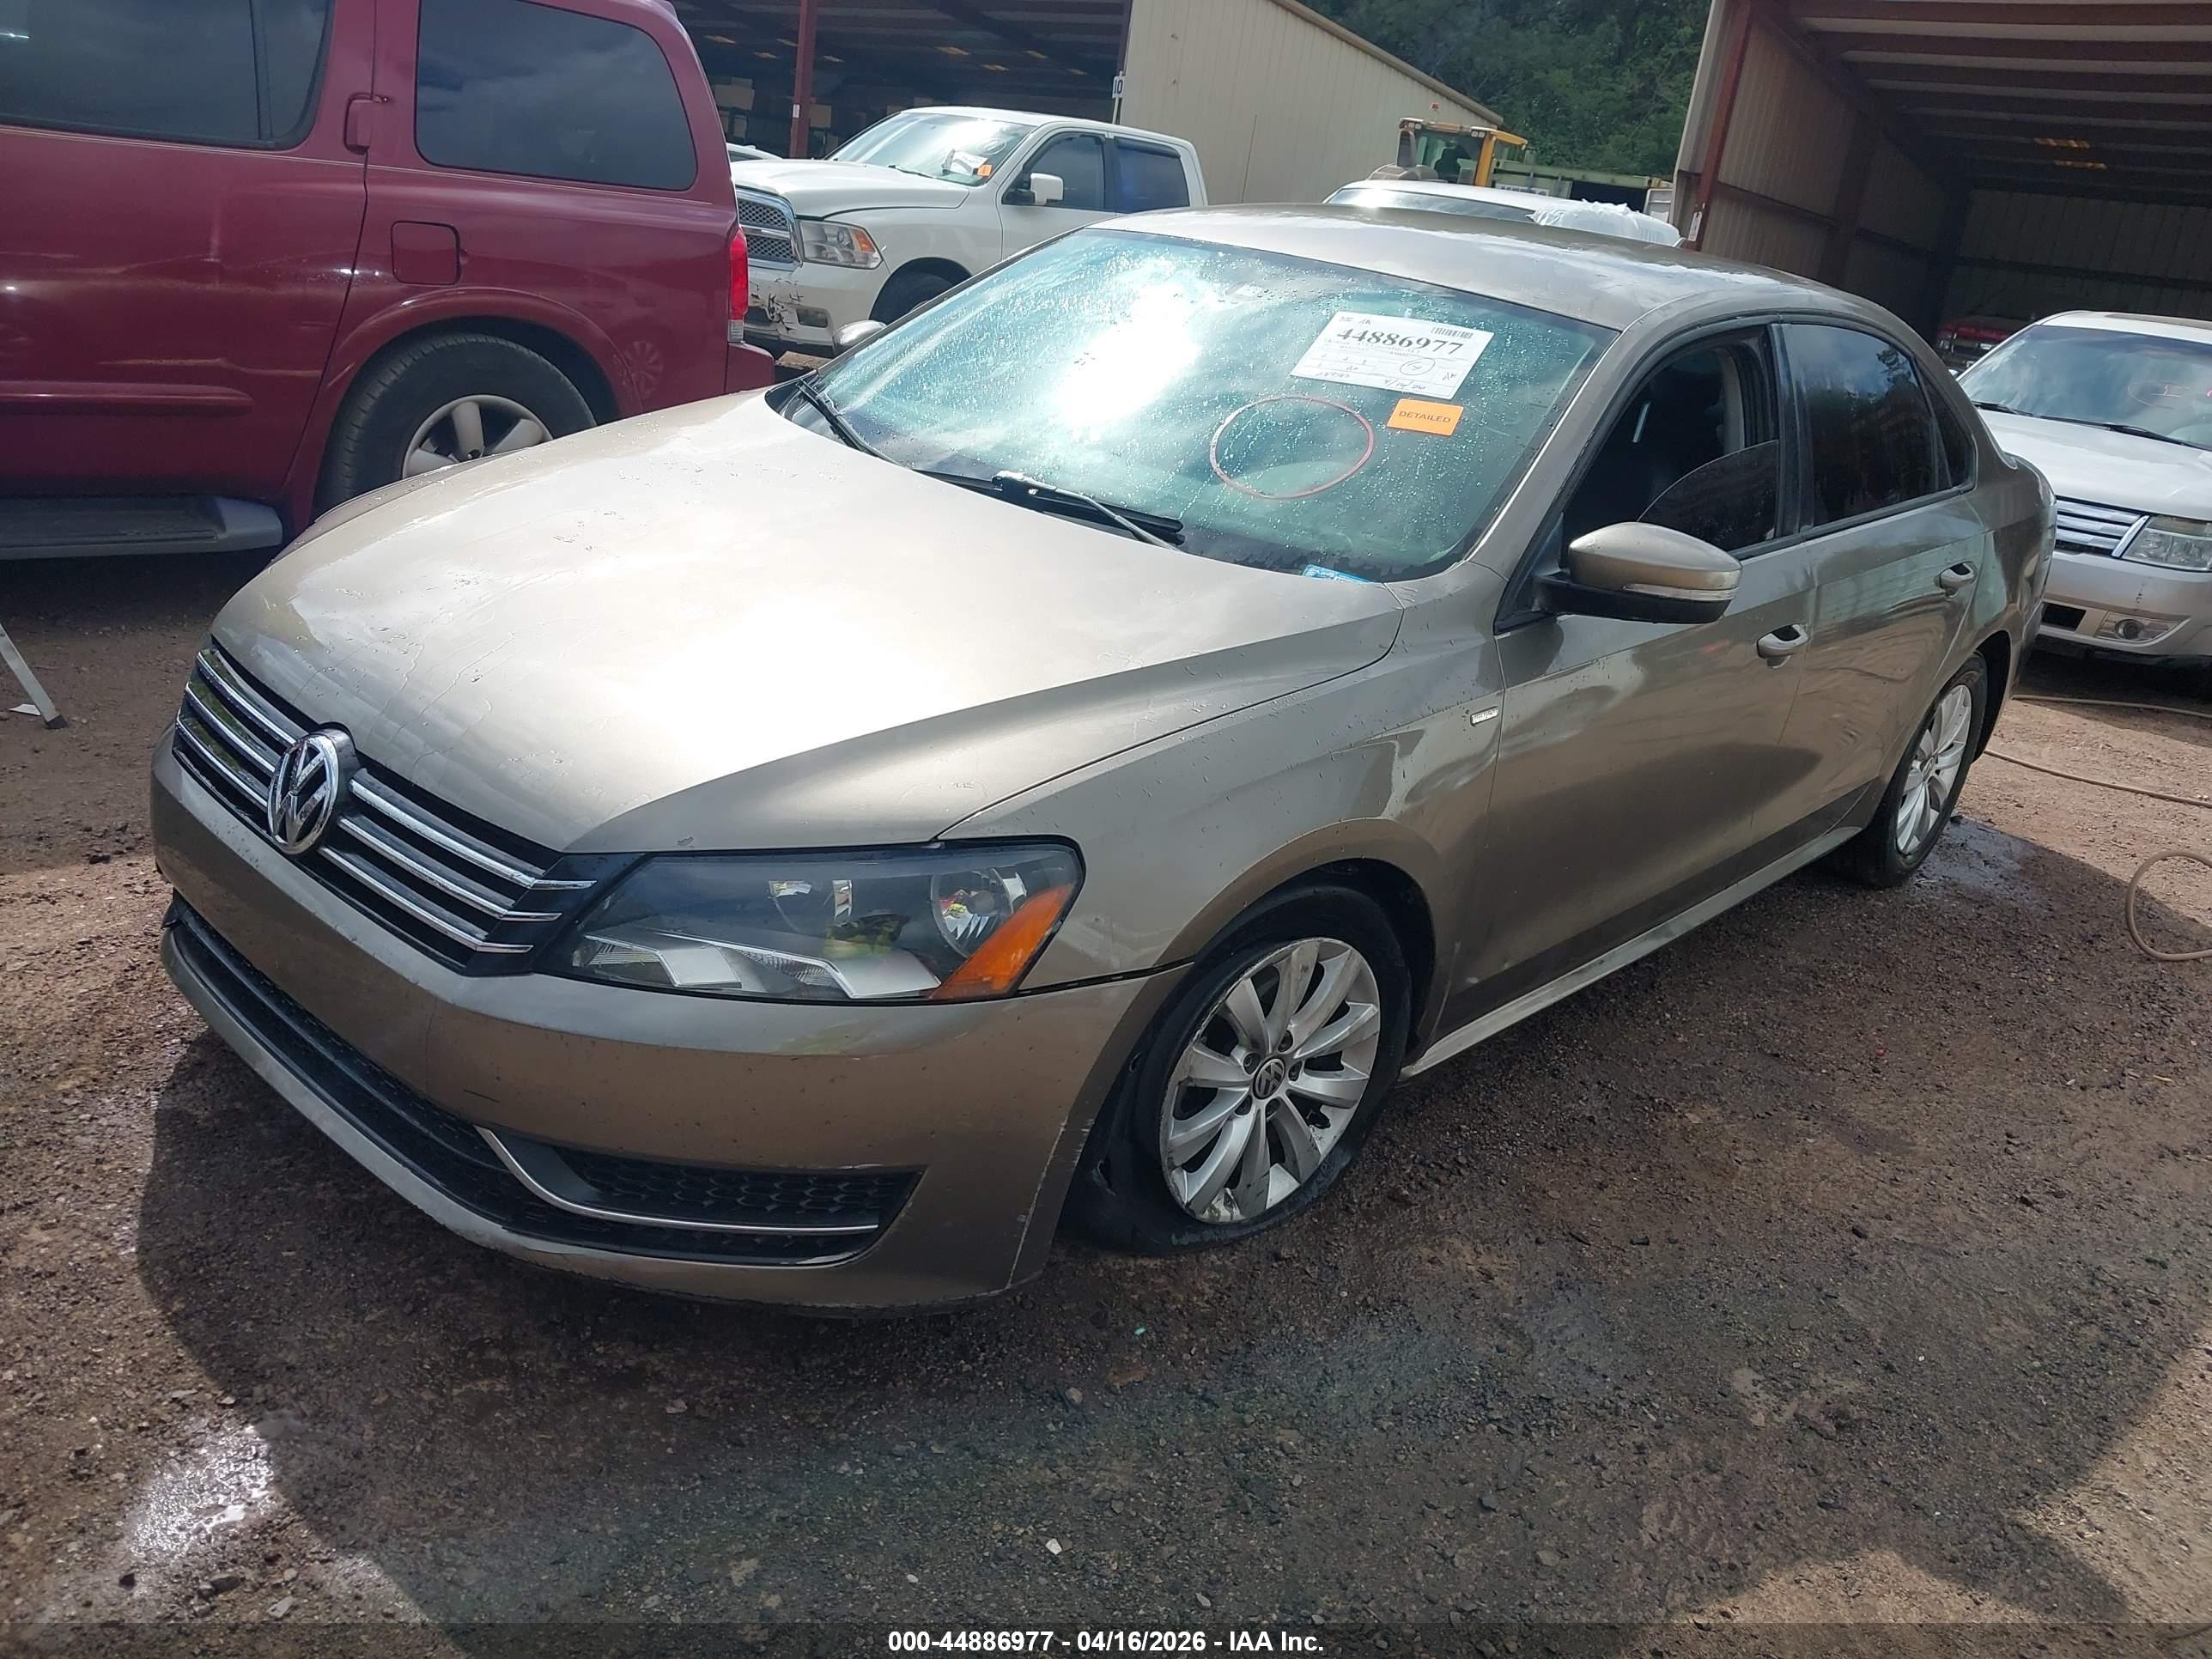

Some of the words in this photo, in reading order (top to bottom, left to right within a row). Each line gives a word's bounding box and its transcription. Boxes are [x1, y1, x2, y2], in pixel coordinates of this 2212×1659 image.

[1113, 79, 1123, 94] 10
[1336, 328, 1464, 356] 44886977
[1399, 410, 1451, 423] DETAILED
